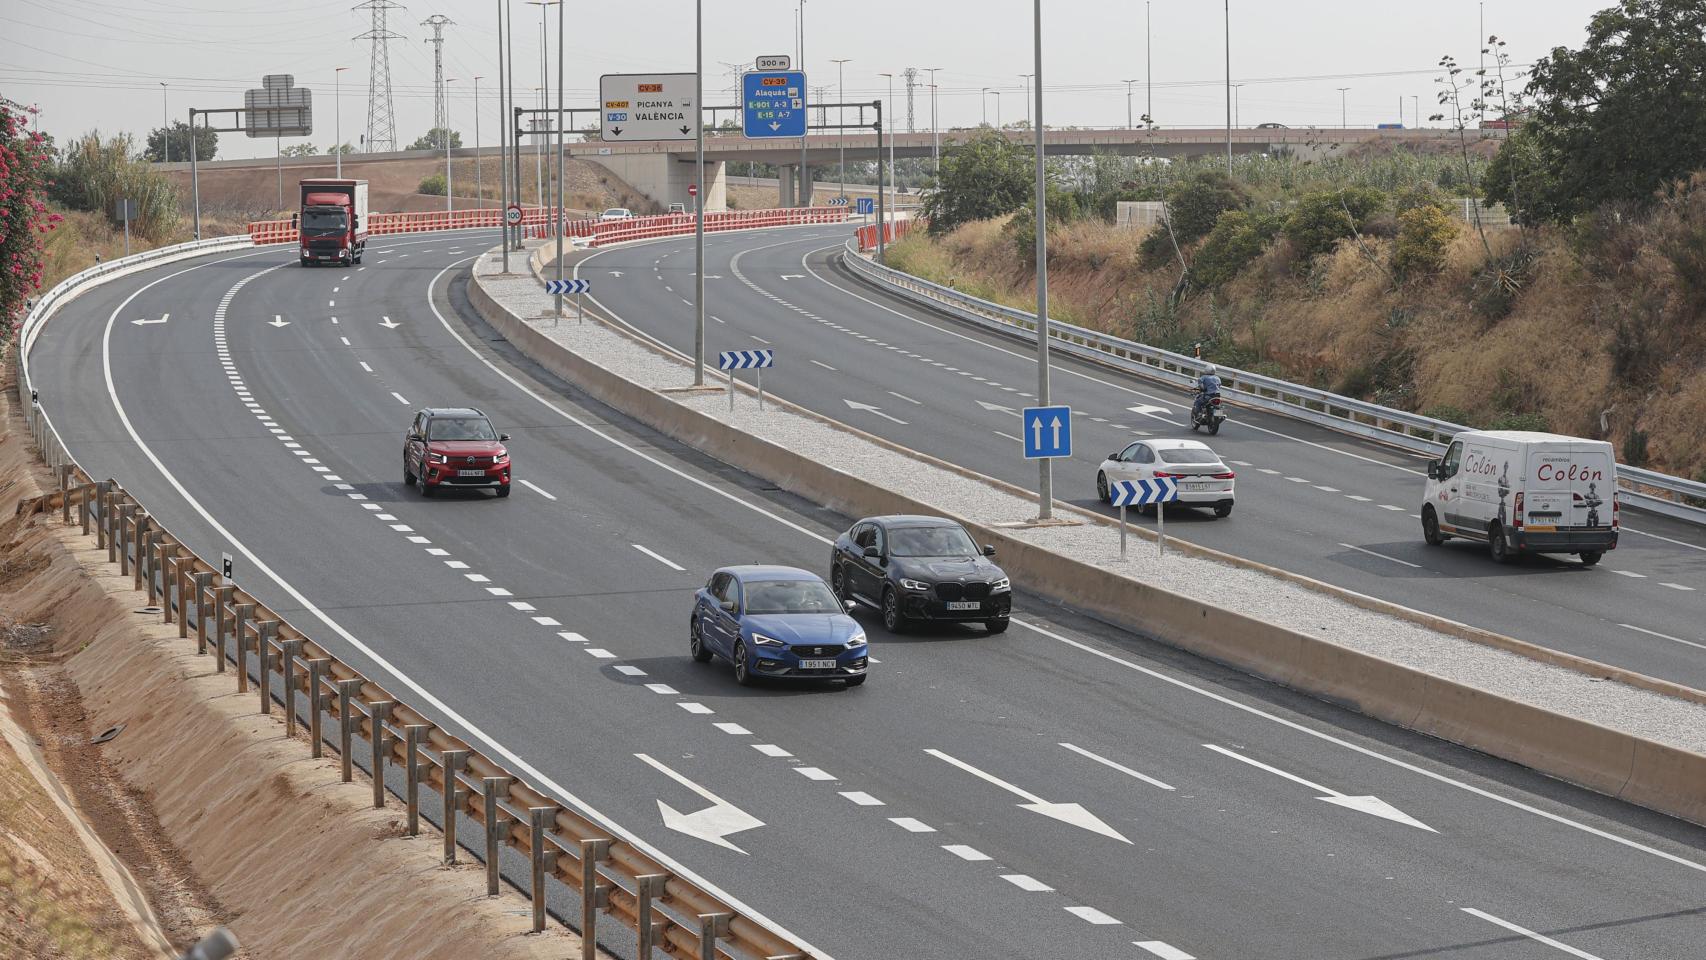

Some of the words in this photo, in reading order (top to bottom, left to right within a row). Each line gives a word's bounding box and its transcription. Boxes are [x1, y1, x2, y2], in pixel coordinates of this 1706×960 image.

[635, 111, 684, 121] VALÈNCIA
[1465, 454, 1497, 476] Colón
[1538, 464, 1602, 480] Colón
